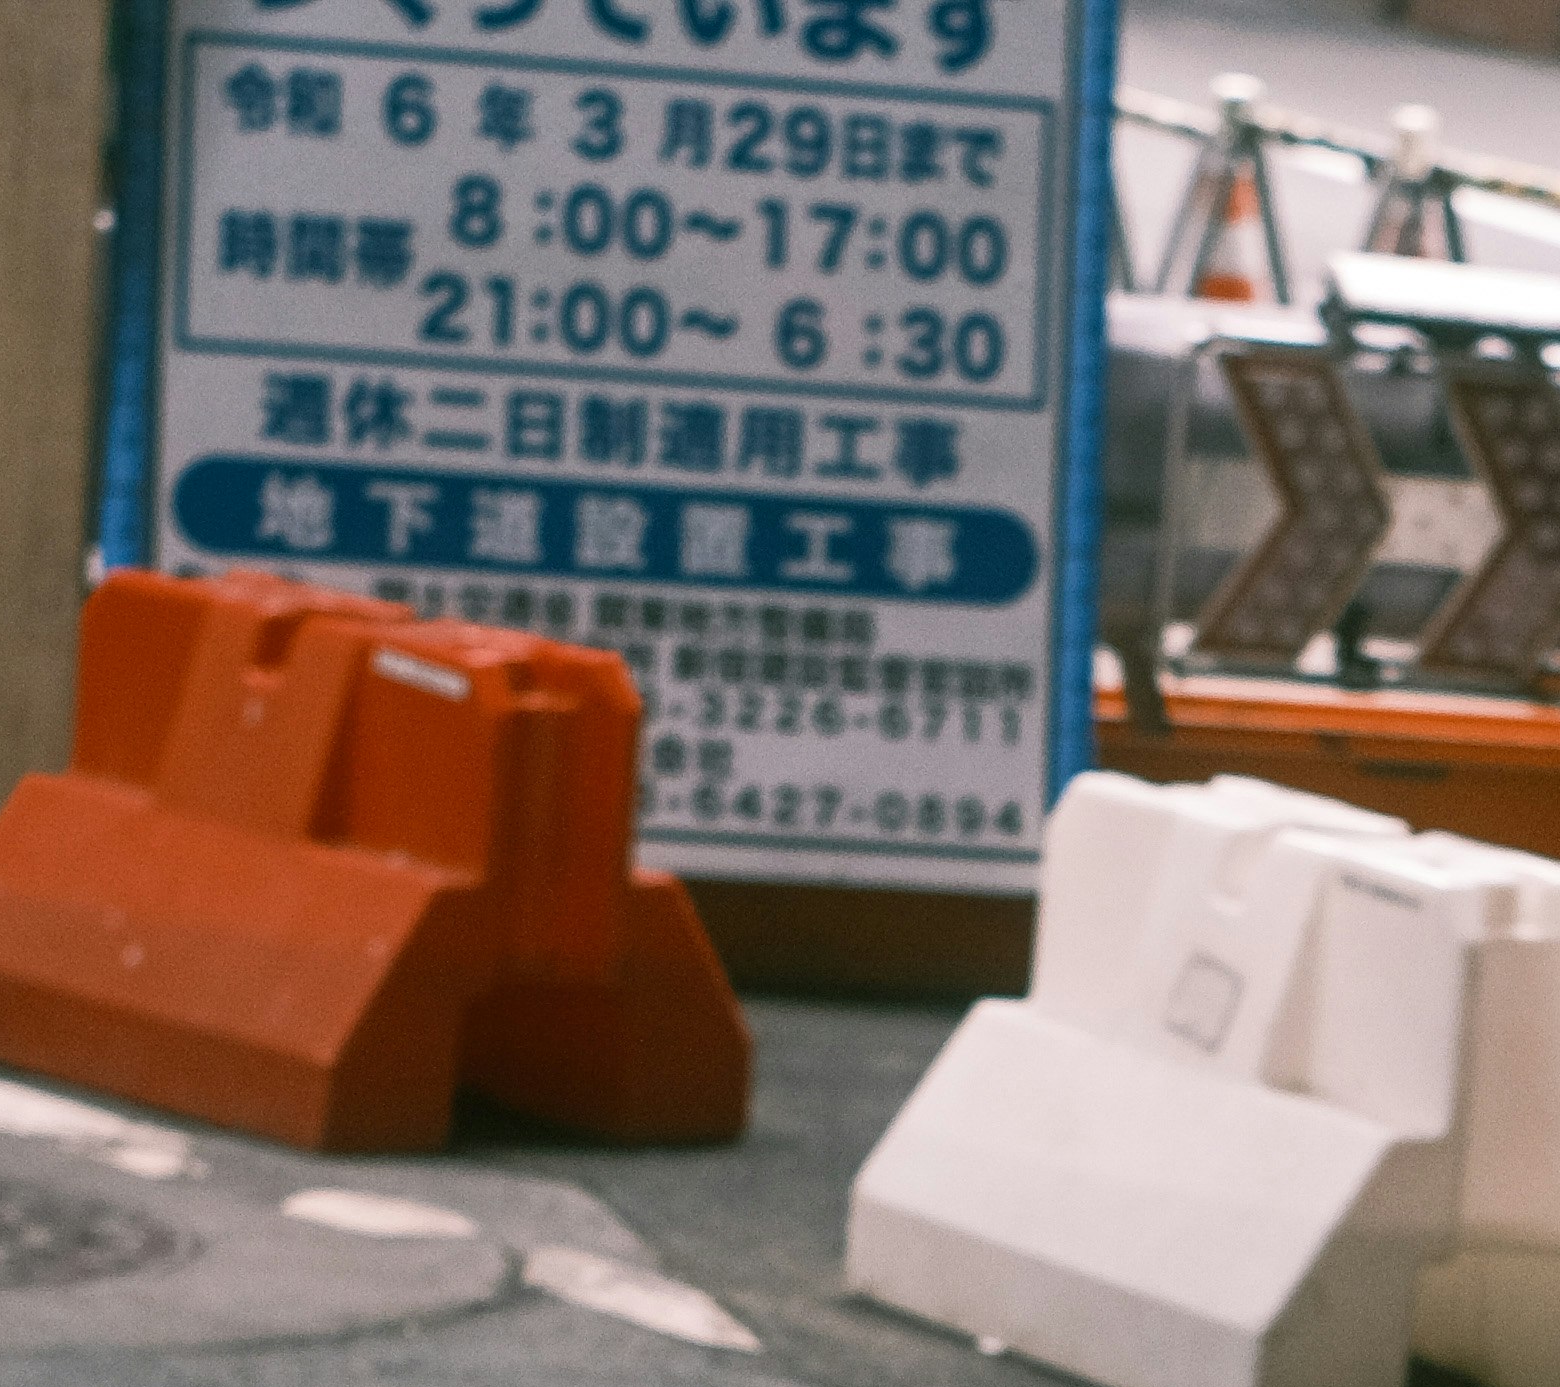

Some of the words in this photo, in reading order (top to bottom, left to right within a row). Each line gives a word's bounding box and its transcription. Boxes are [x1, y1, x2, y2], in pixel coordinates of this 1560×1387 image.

[217, 209, 414, 287] 時間帯
[259, 371, 963, 488] 週休二日制適用工事
[257, 471, 957, 590] 地下道設置工事
